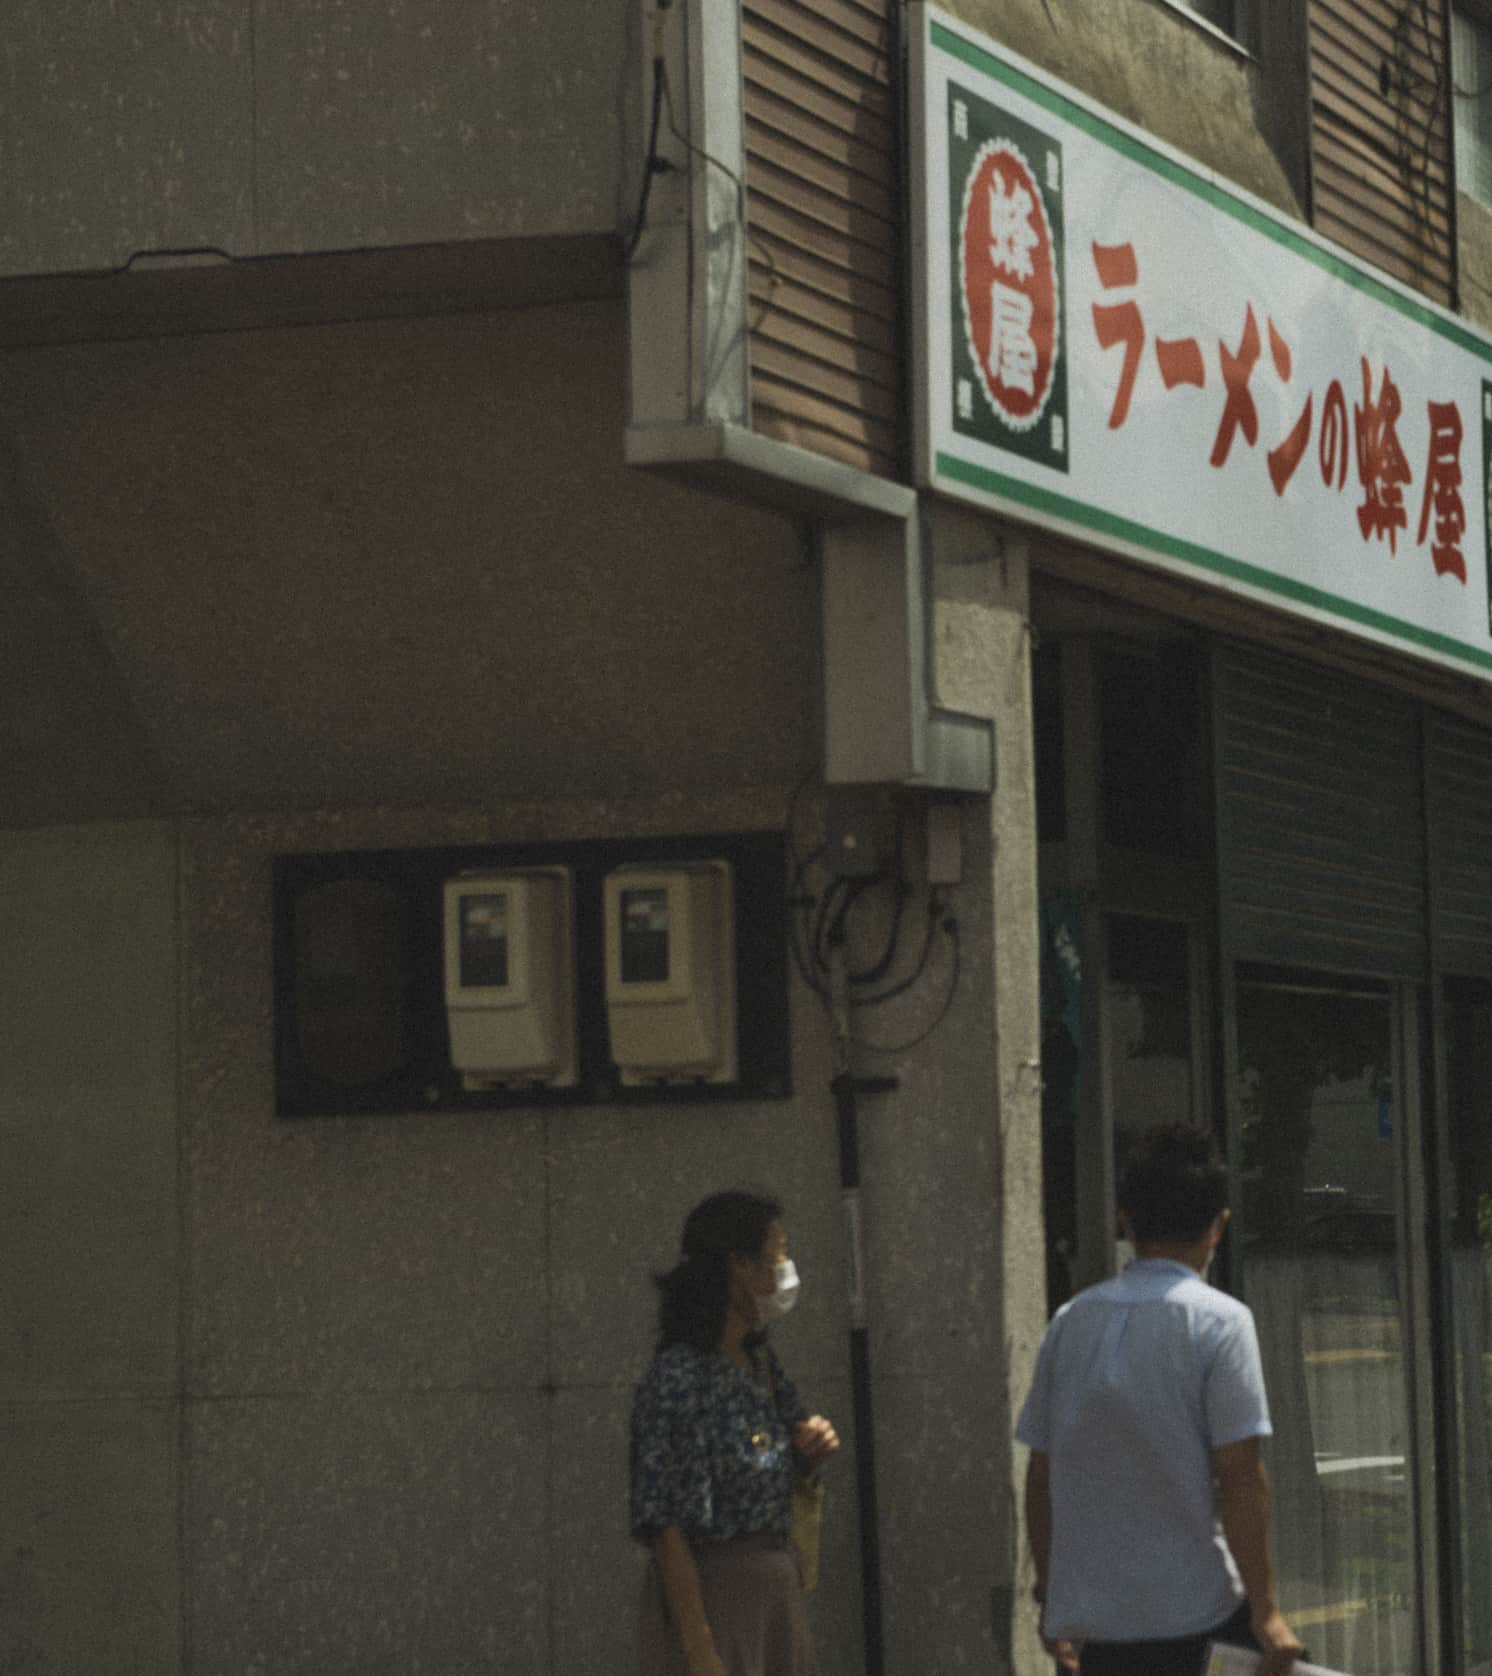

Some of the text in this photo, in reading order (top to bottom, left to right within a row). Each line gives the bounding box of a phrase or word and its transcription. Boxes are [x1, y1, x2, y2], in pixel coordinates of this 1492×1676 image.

[1091, 240, 1467, 585] ラーメンの蜂屋
